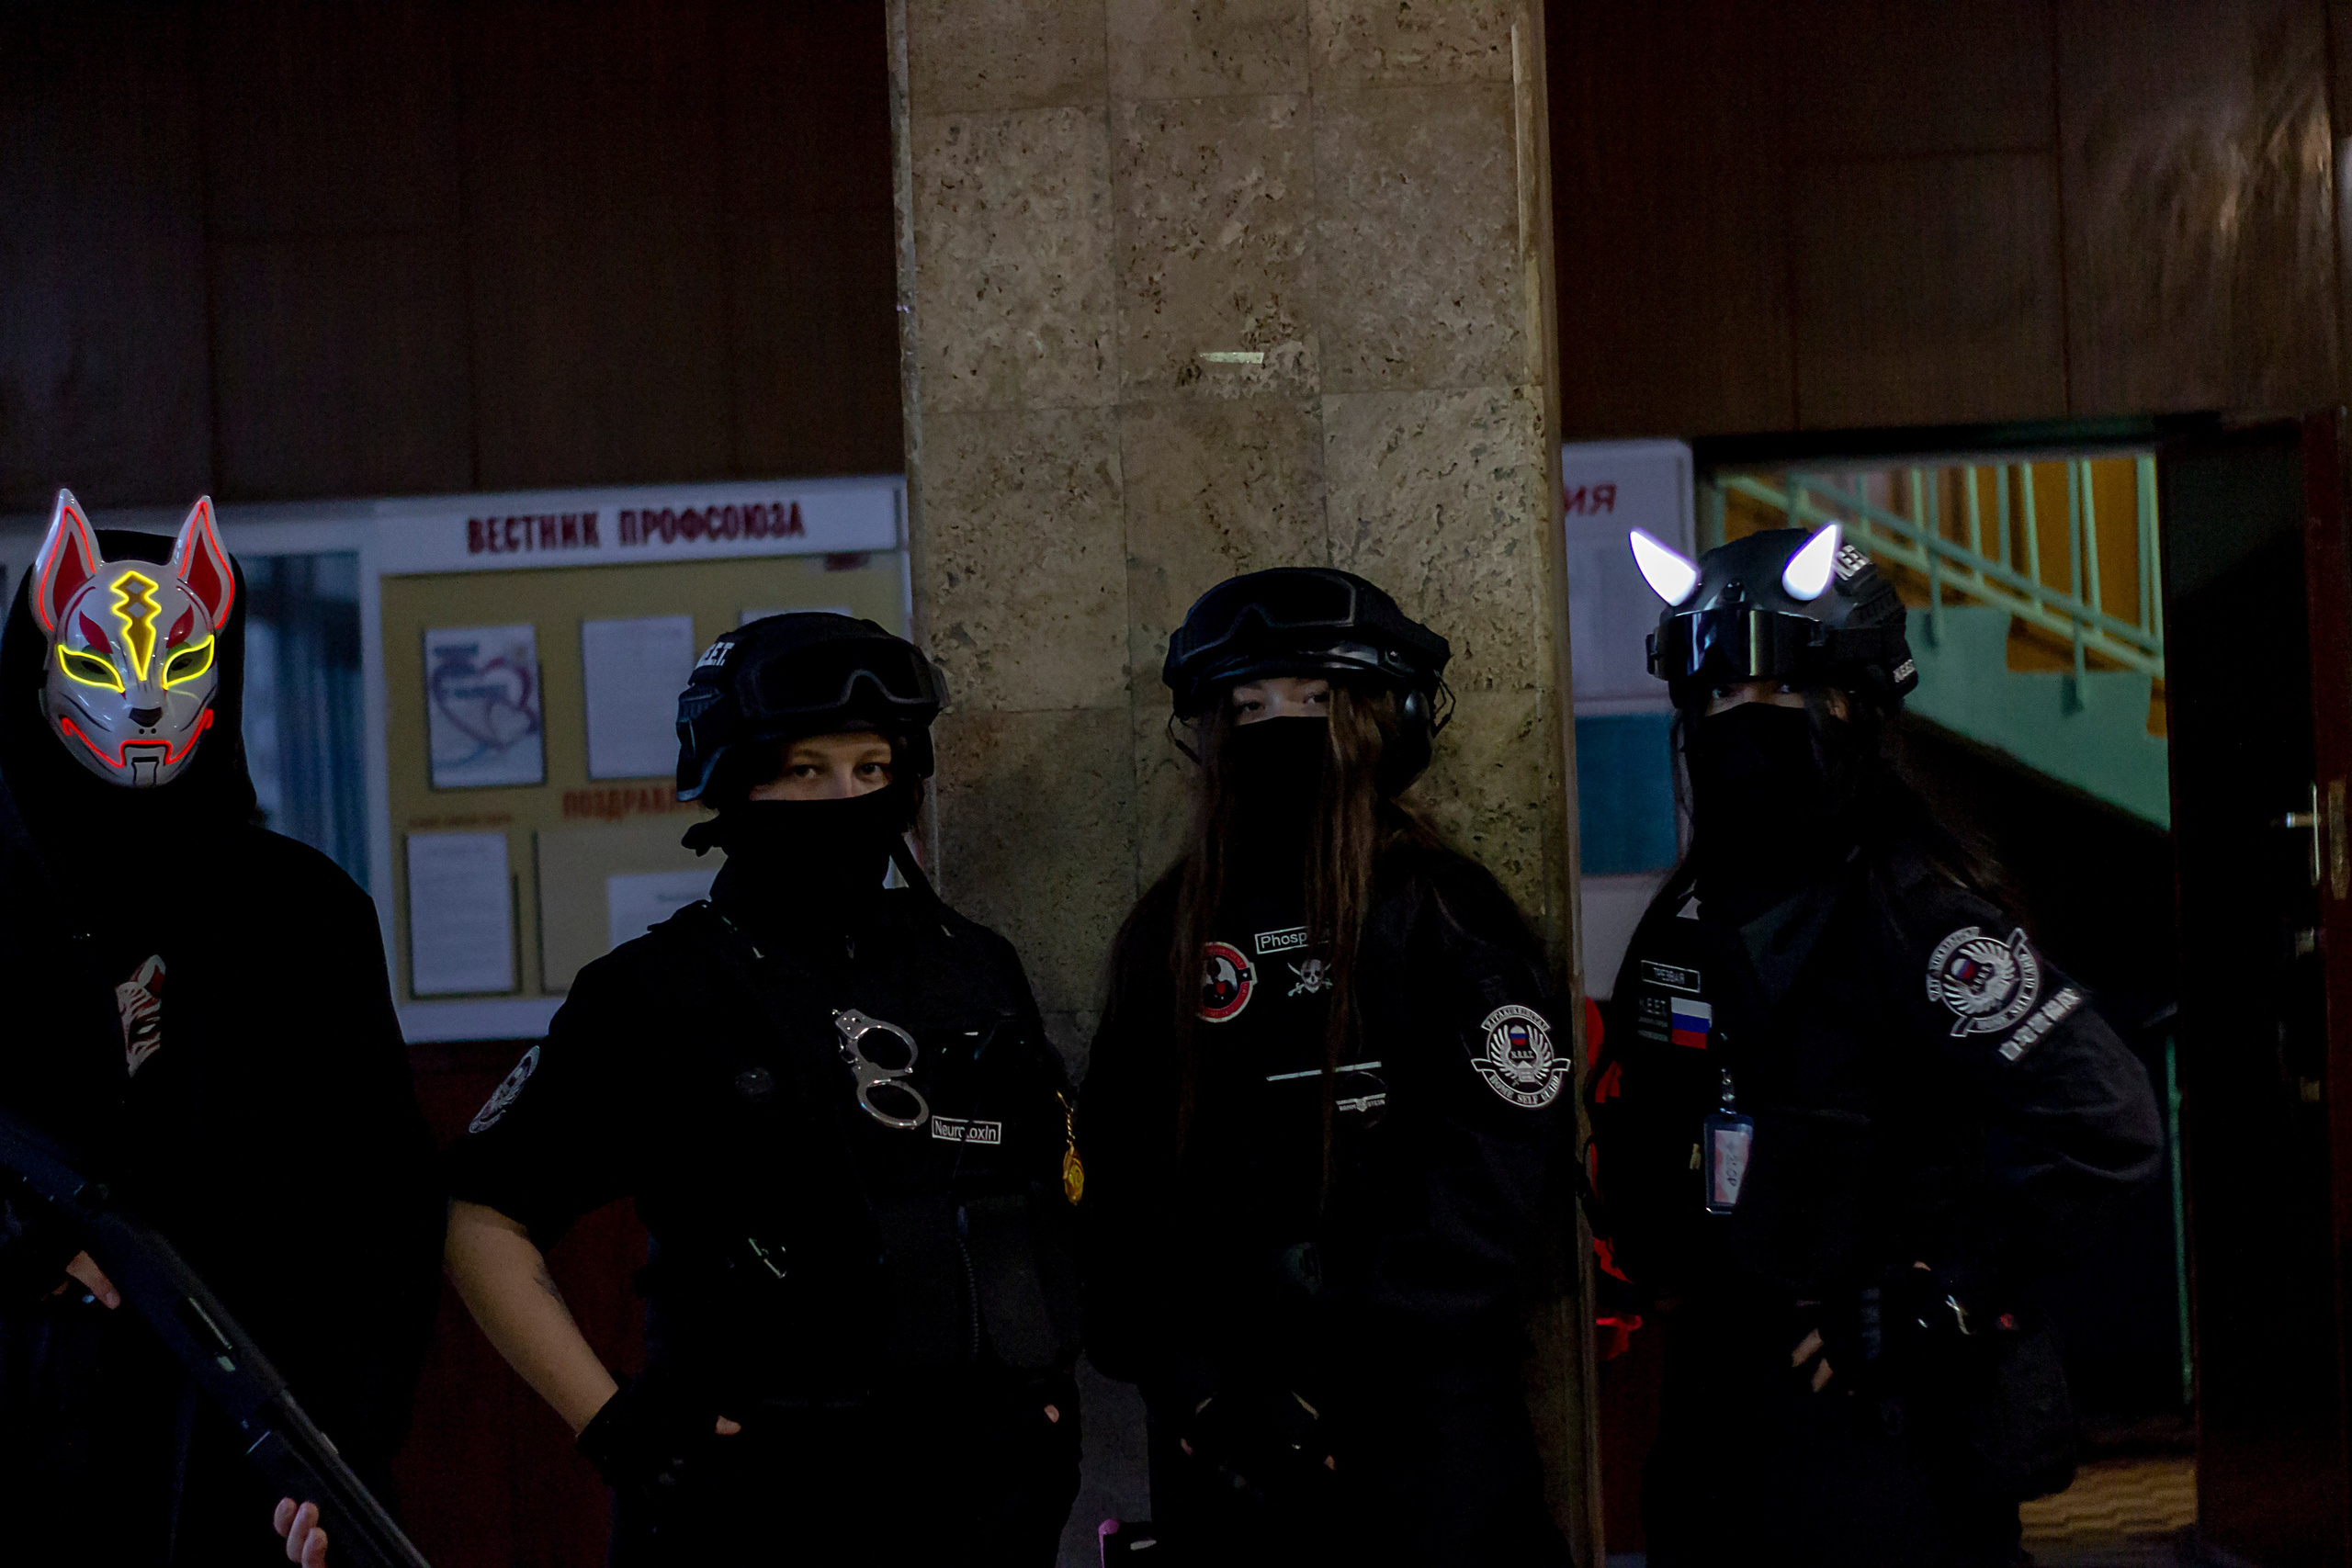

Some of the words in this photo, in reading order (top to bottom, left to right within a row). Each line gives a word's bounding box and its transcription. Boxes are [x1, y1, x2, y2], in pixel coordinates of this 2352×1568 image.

[469, 512, 599, 553] ВЕСТНИК
[619, 502, 805, 547] ПРОФСОЮЗА
[1260, 931, 1308, 950] Phosp
[934, 1119, 997, 1141] Neurooxin
